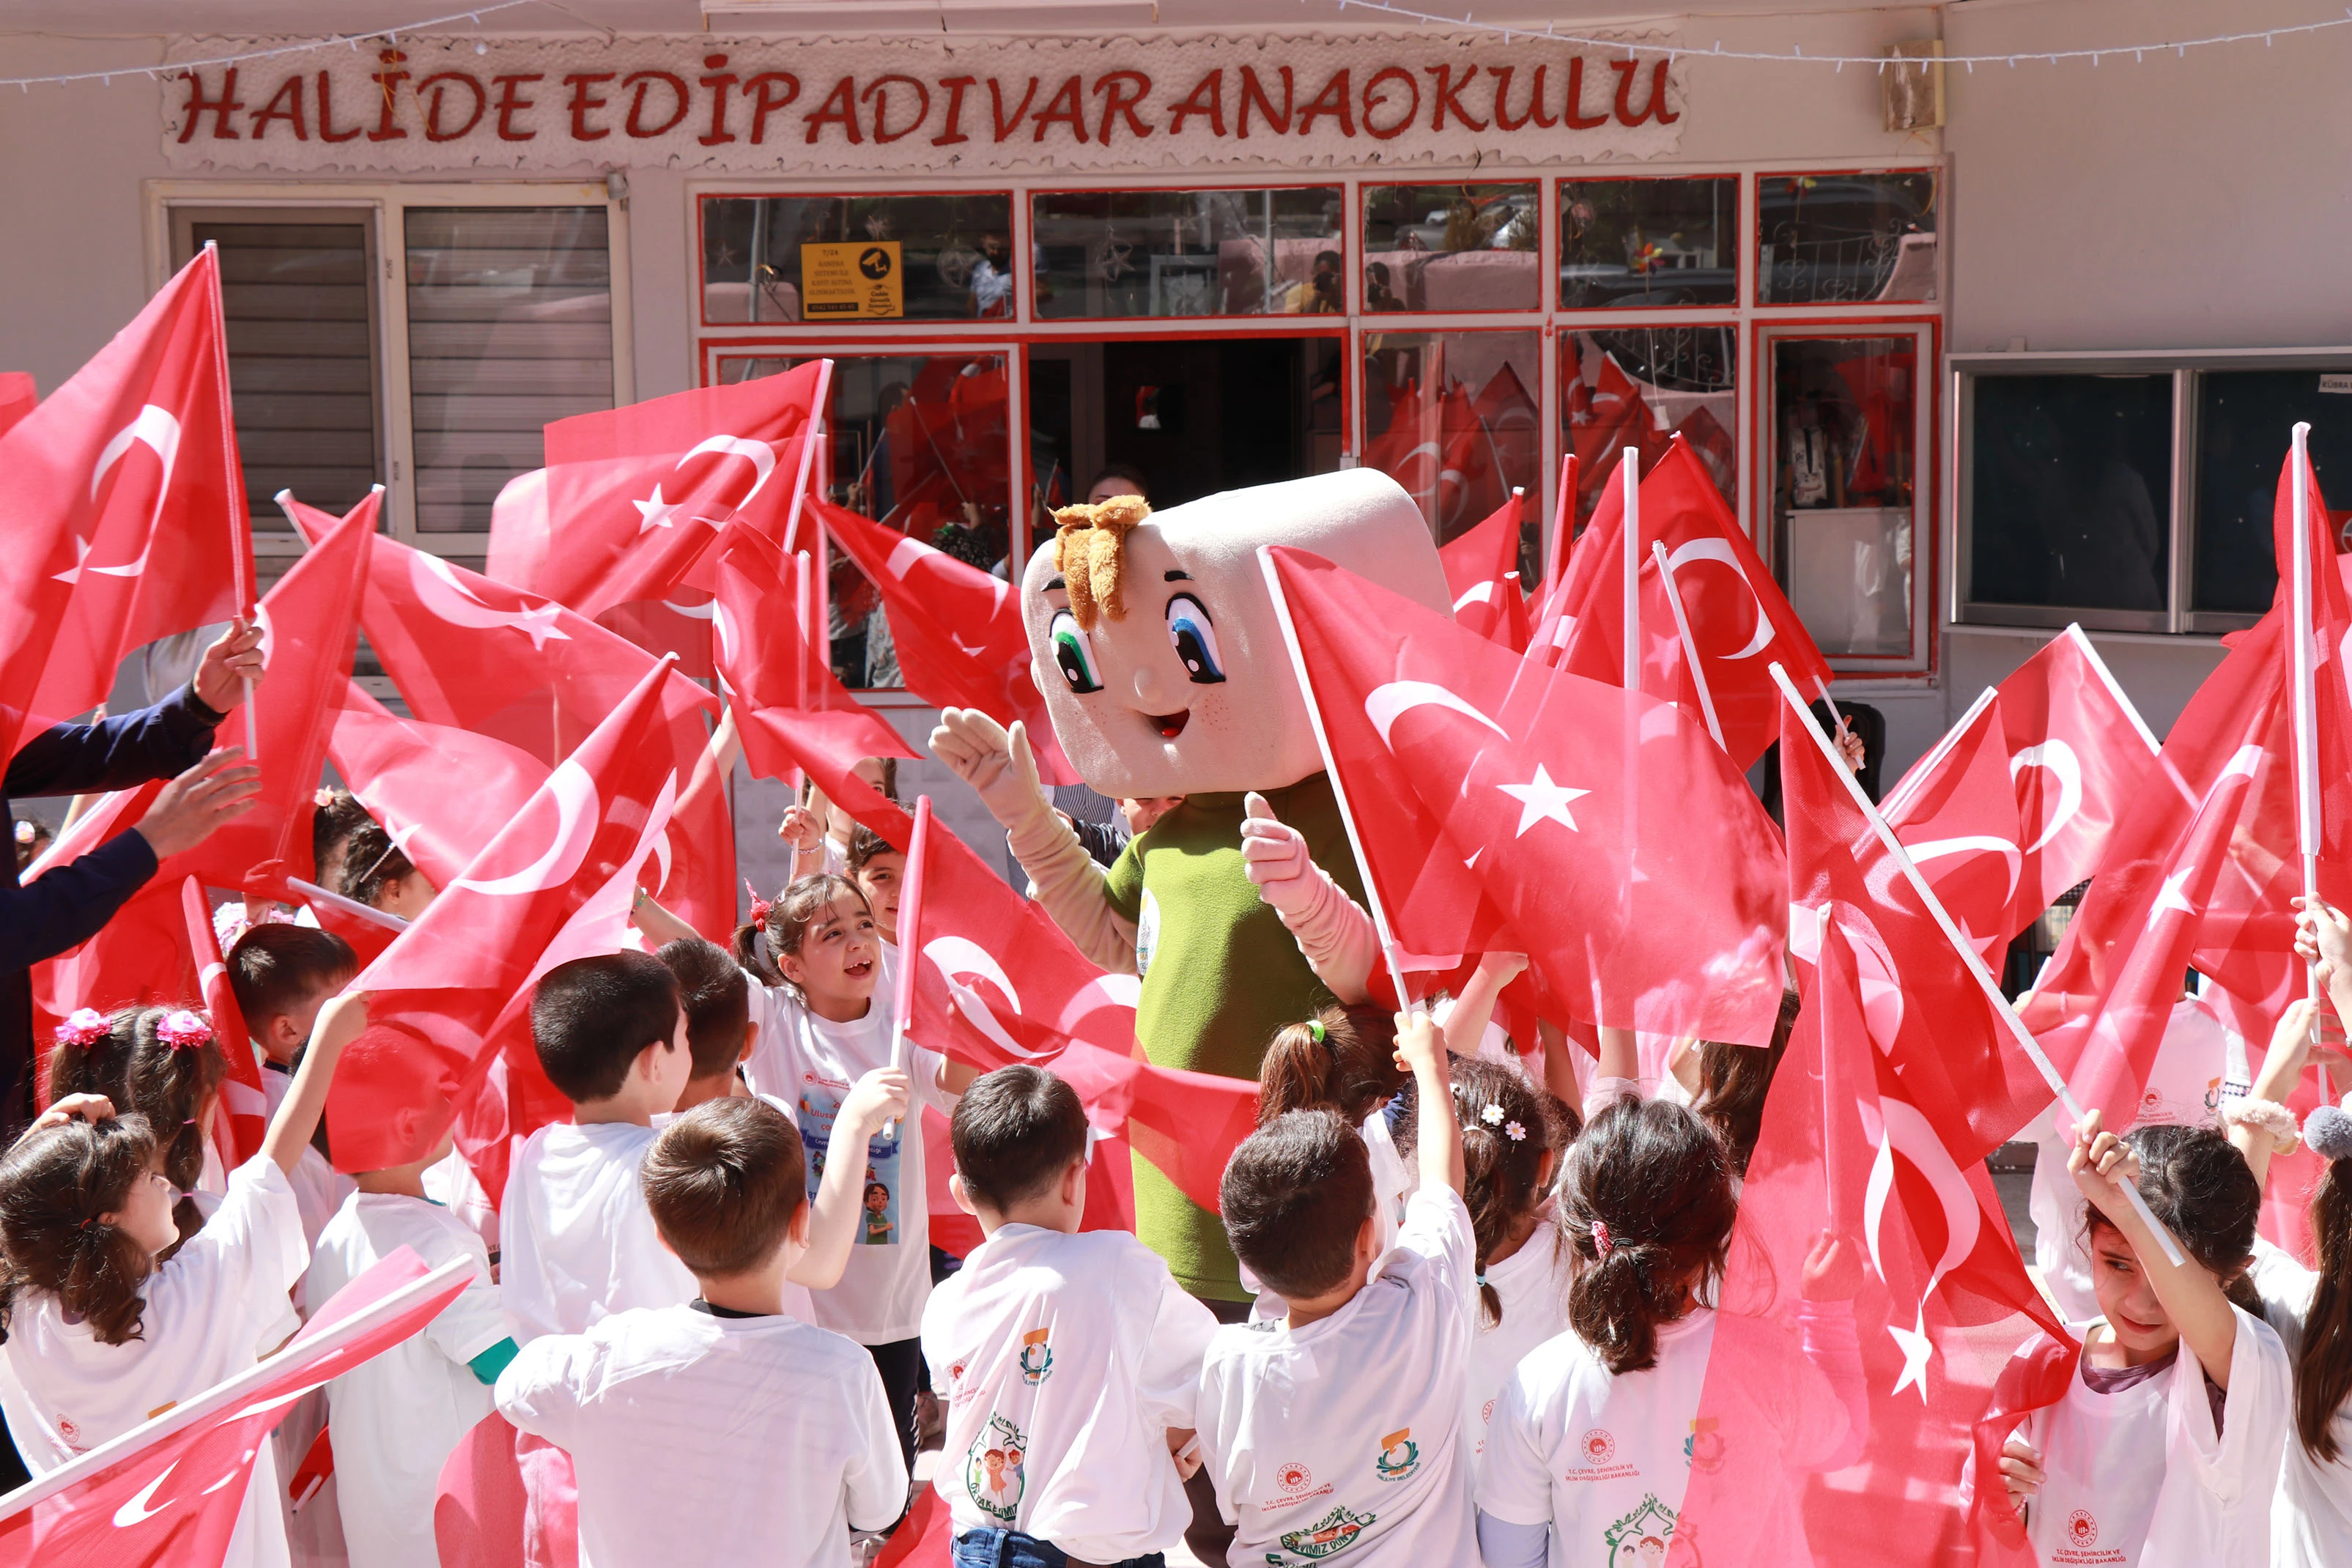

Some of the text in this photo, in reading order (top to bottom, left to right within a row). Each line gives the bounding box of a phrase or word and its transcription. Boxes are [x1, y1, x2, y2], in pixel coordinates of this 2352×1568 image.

[177, 49, 1681, 148] HALİDE EDİP ADIVAR ANAOKULU
[2321, 380, 2348, 388] KÜBRA
